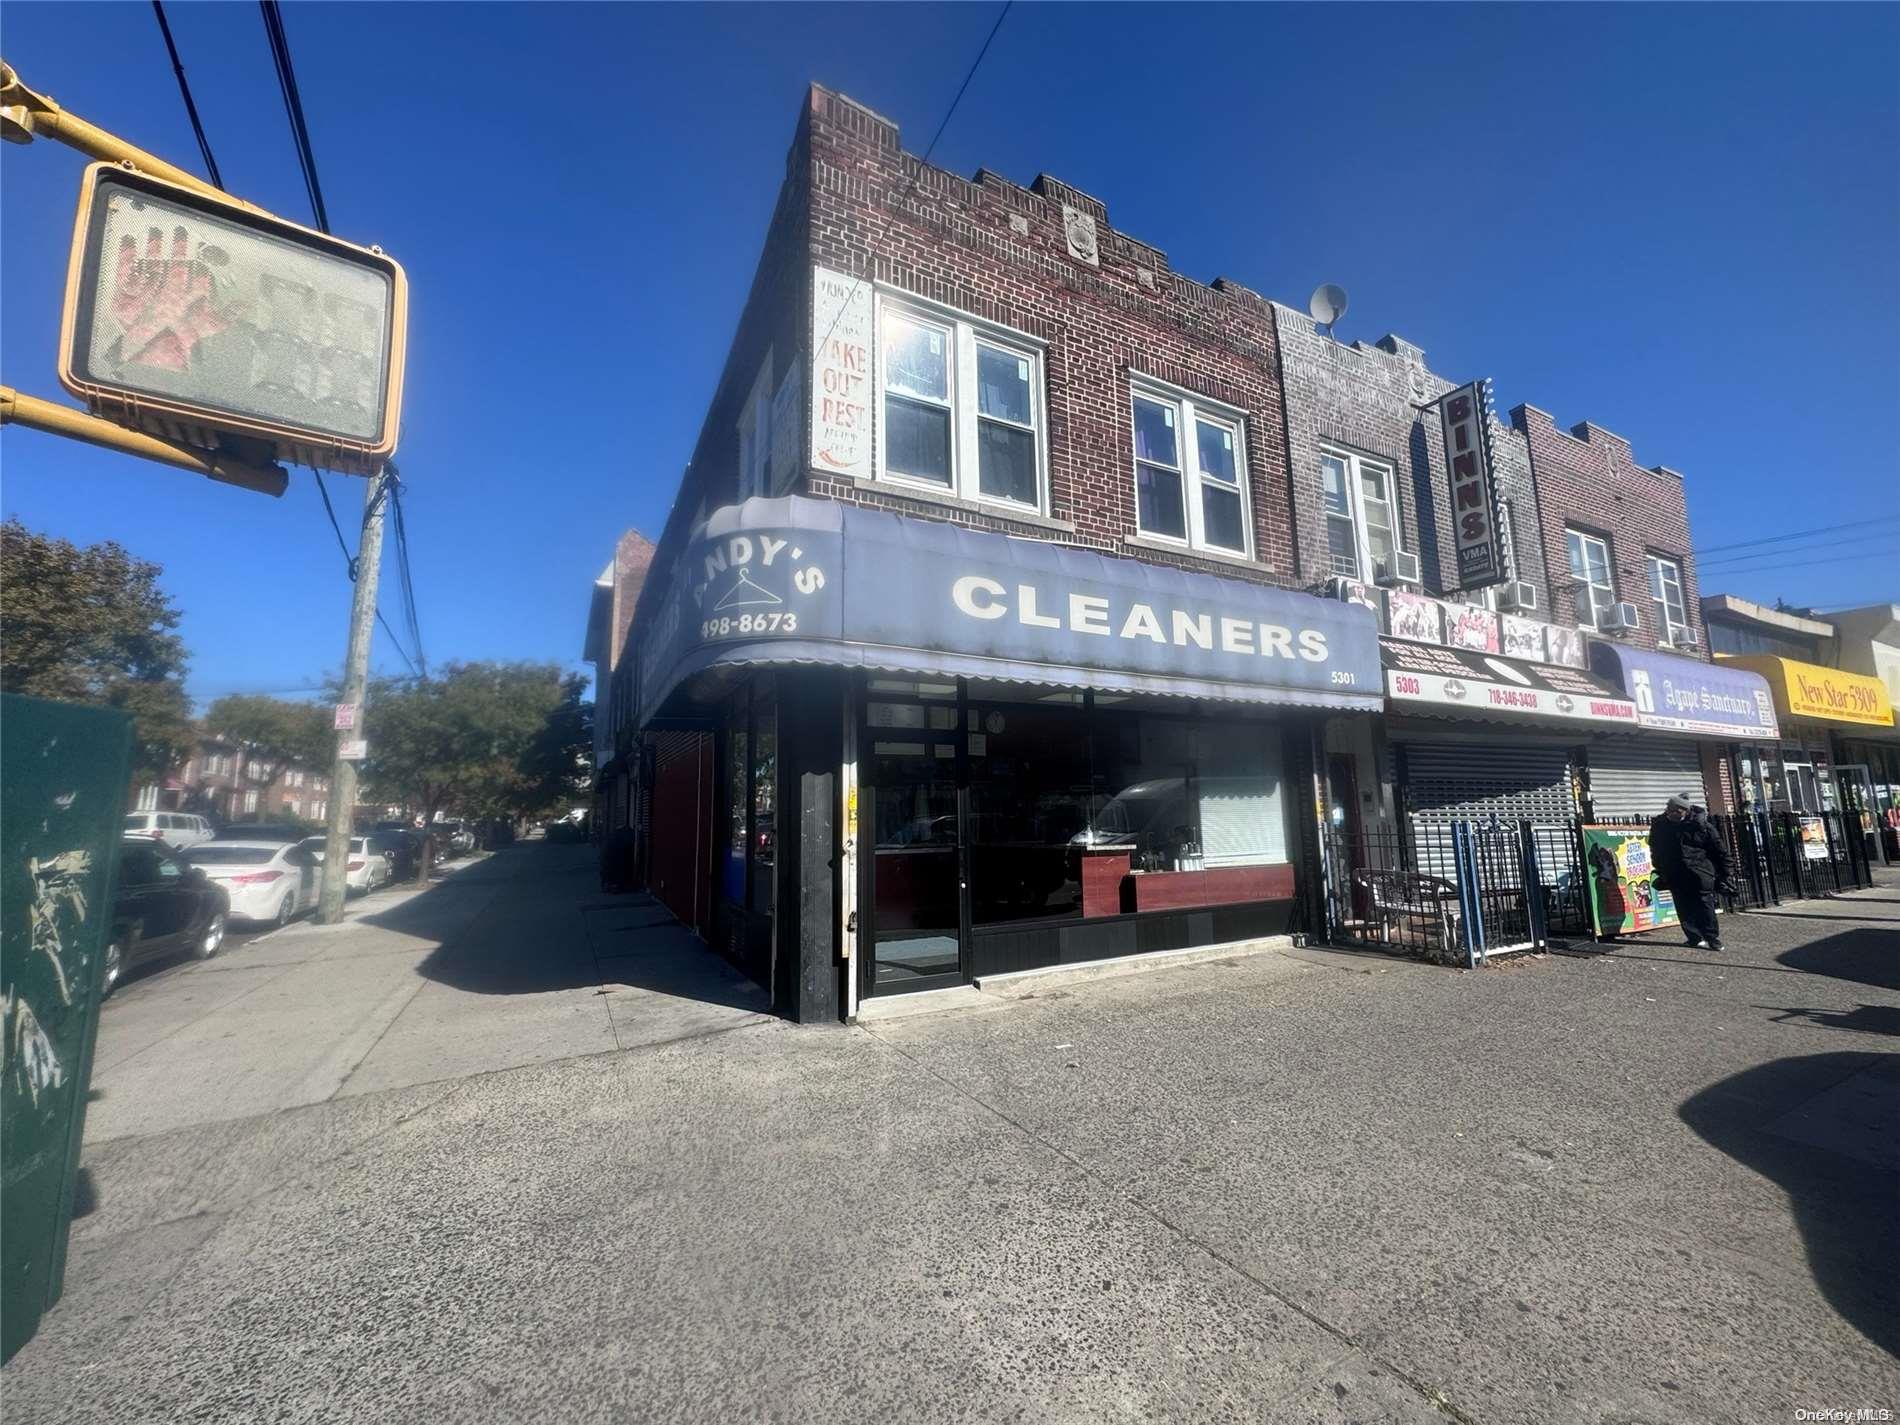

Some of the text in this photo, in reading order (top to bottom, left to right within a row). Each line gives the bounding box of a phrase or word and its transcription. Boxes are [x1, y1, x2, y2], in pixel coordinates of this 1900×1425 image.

[822, 337, 867, 373] TAKE
[823, 368, 863, 397] OUT
[1447, 395, 1487, 541] BINNS
[1462, 545, 1489, 561] VMA
[952, 576, 1329, 663] CLEANERS
[1331, 670, 1355, 685] 5301
[1396, 676, 1420, 695] 5303
[1488, 689, 1538, 708] 718-346-3438
[1797, 674, 1878, 712] New Star 5309
